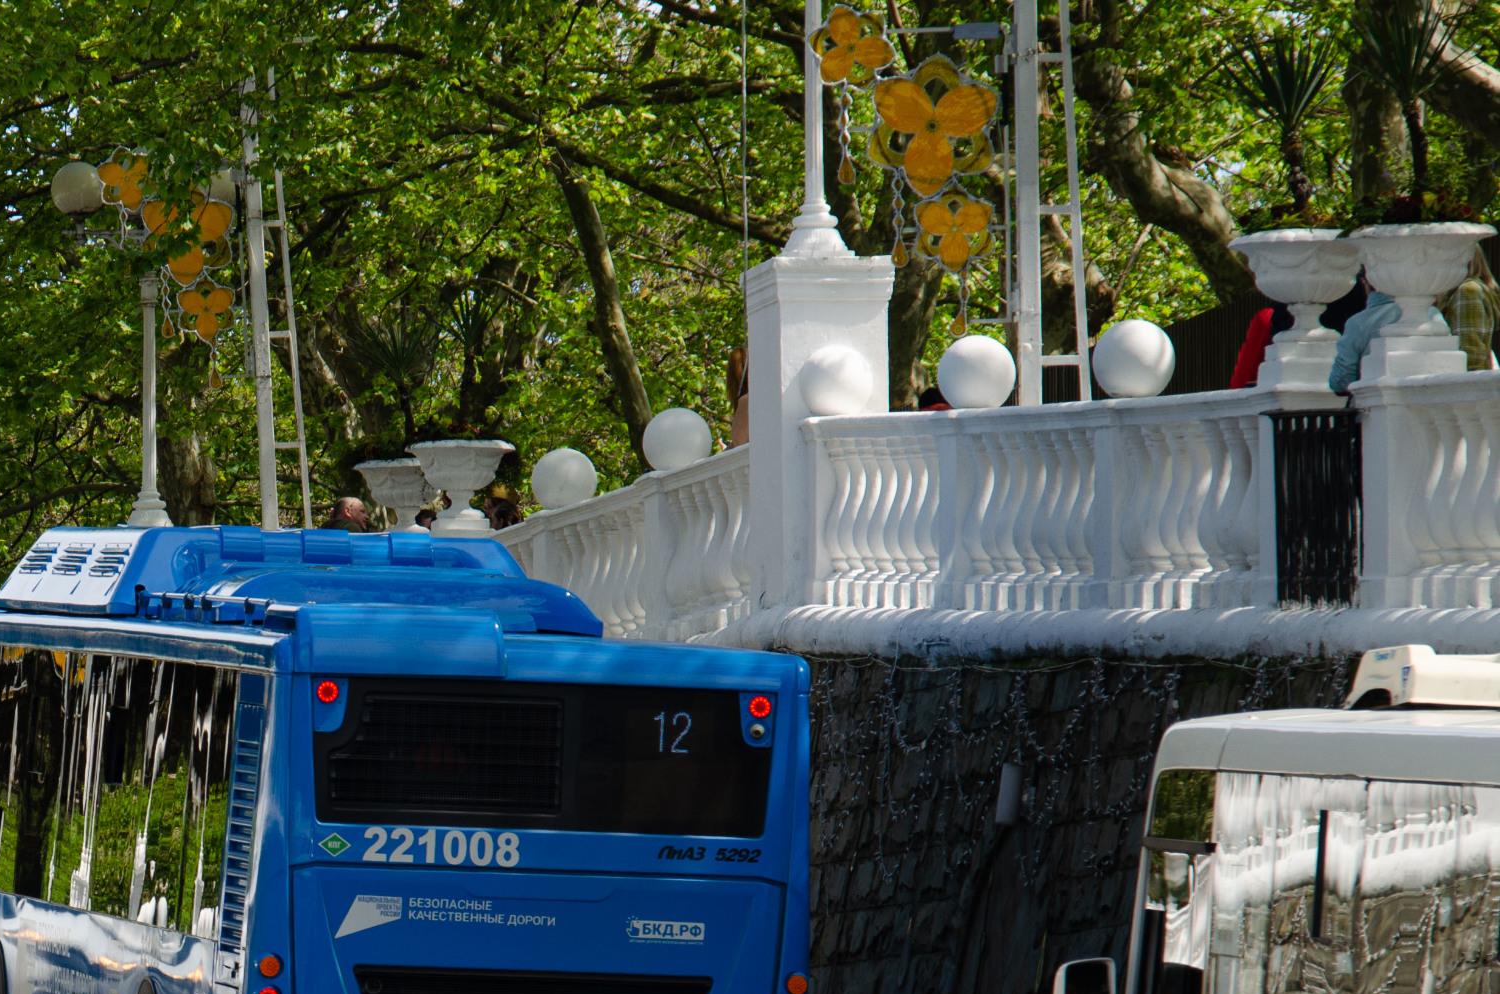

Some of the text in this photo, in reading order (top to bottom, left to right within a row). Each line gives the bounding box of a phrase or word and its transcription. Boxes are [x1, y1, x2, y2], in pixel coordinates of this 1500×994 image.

[654, 711, 692, 753] 12
[362, 826, 521, 868] 221008
[715, 848, 762, 863] 5292
[408, 897, 493, 911] БЕЗОПАСНЫЕ
[408, 911, 556, 926] КАЧЕСТВЕННЫЕ ДОРОГИ
[642, 923, 703, 938] БКД.РФ
